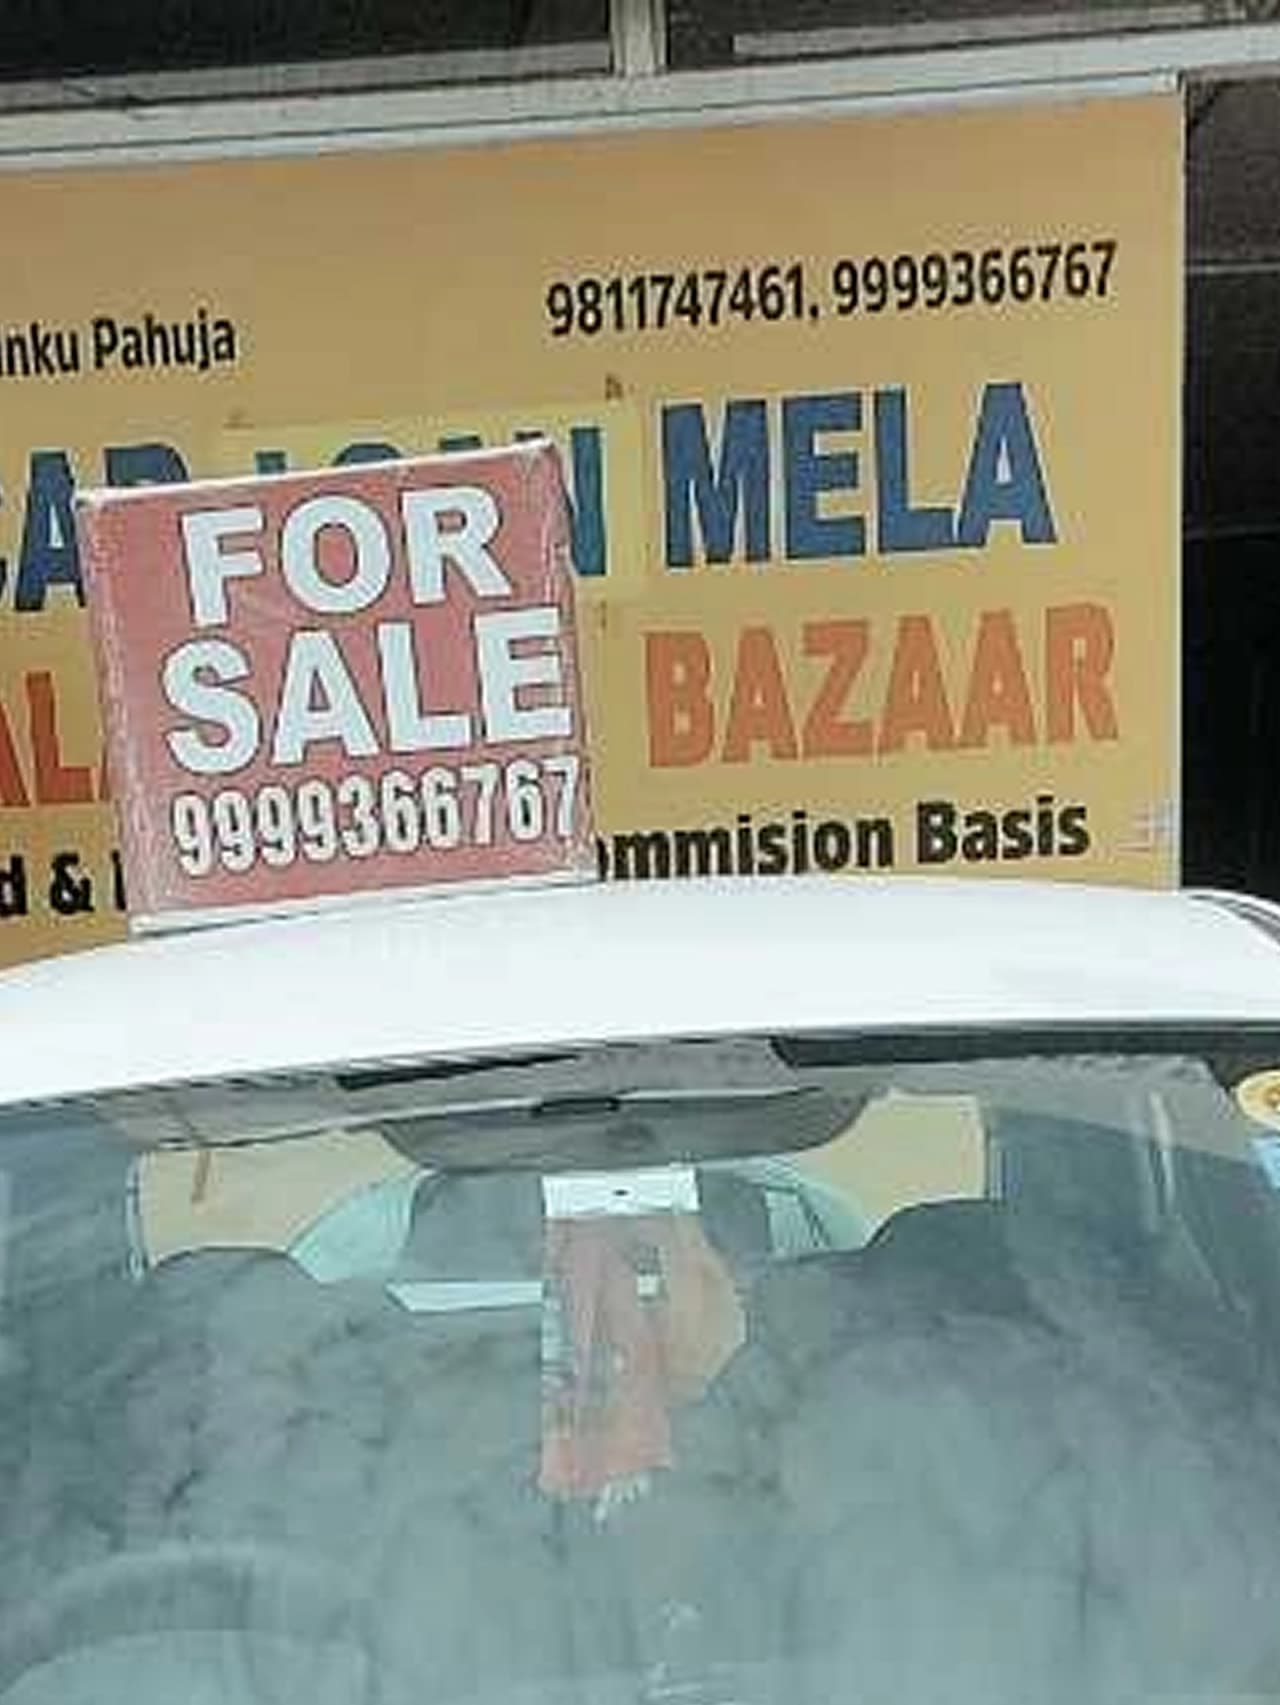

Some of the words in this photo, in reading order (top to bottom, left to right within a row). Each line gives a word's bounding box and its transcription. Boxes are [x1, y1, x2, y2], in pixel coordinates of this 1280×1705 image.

[92, 308, 237, 370] Pahuja
[832, 241, 1117, 316] 9999366767
[660, 381, 1057, 570] MELA
[180, 485, 513, 629] FOR
[161, 605, 573, 776] SALE
[642, 601, 1118, 769] BAZAAR
[50, 851, 94, 915] &
[916, 795, 1090, 865] Basis
[172, 755, 580, 877] 9999366767
